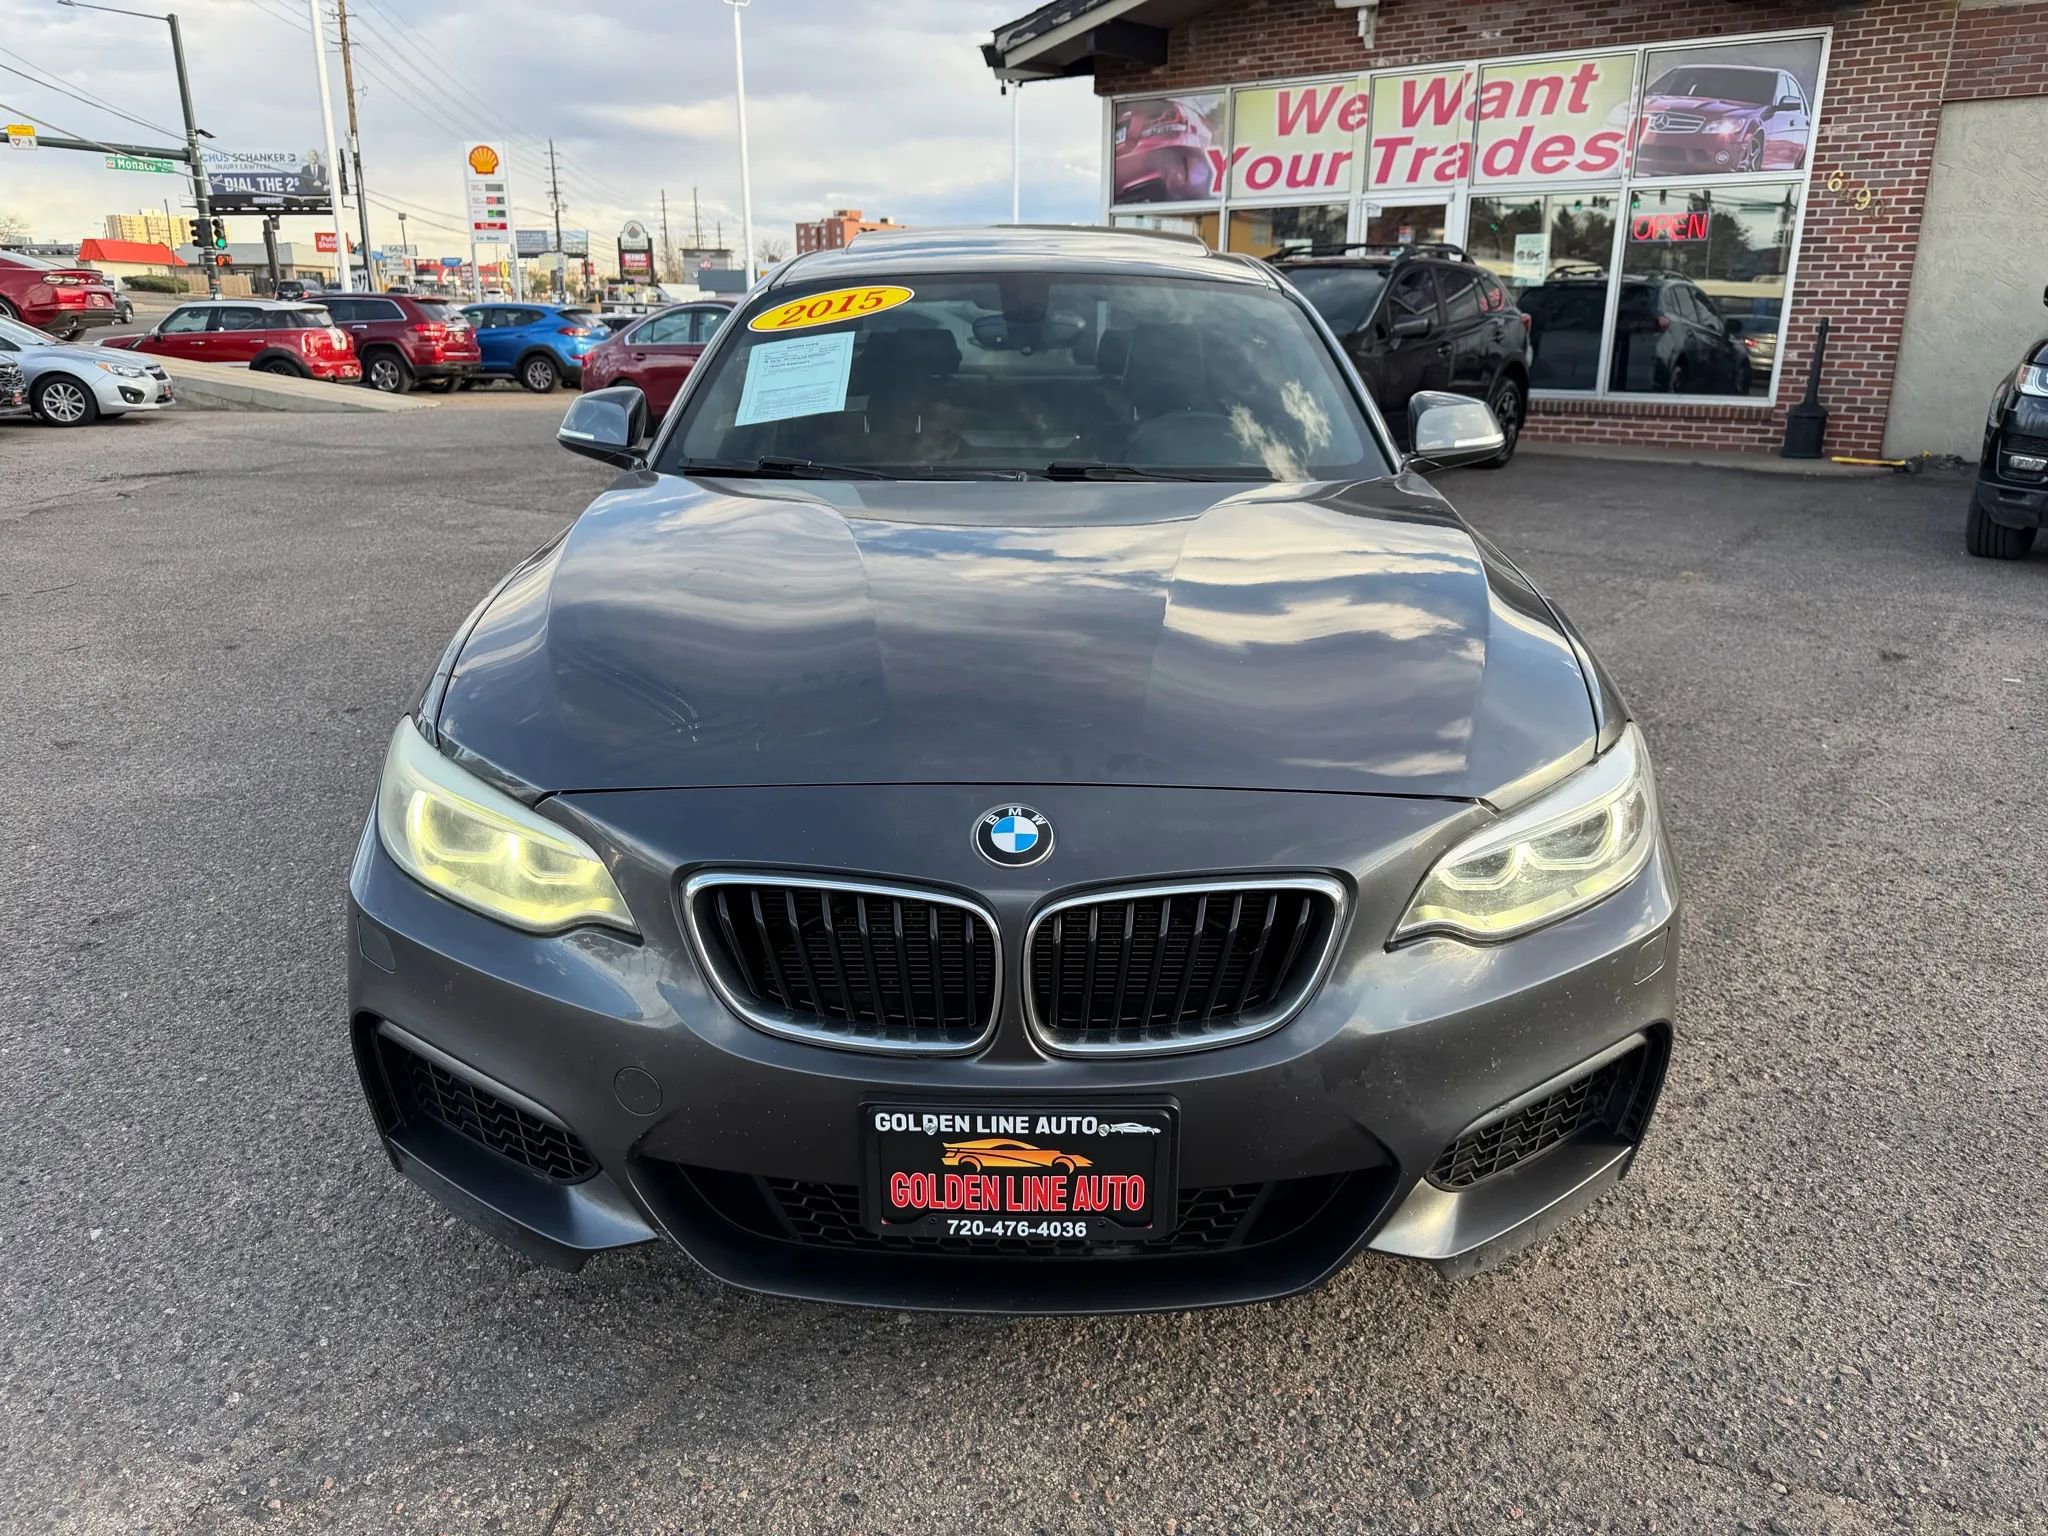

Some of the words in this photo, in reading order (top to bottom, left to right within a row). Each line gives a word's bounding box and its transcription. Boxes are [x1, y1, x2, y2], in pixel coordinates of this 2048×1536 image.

[1277, 86, 1368, 136] We
[1401, 63, 1599, 128] Want
[117, 158, 156, 171] Monaco
[232, 153, 285, 162] SCHANKER
[1207, 146, 1353, 193] Your
[1372, 118, 1648, 183] Trades!
[223, 176, 256, 192] DIAL
[257, 176, 284, 192] THE
[1634, 213, 1707, 240] OPEN
[777, 290, 887, 327] 2015
[985, 807, 1047, 826] BMW
[874, 1112, 970, 1134] GOLDEN
[976, 1115, 1029, 1134] LINE
[1035, 1116, 1098, 1135] AUTO
[890, 1171, 1000, 1211] GOLDEN
[1006, 1175, 1067, 1212] LINE
[1072, 1174, 1145, 1211] AUTO
[947, 1219, 1087, 1237] 720-476-4036
